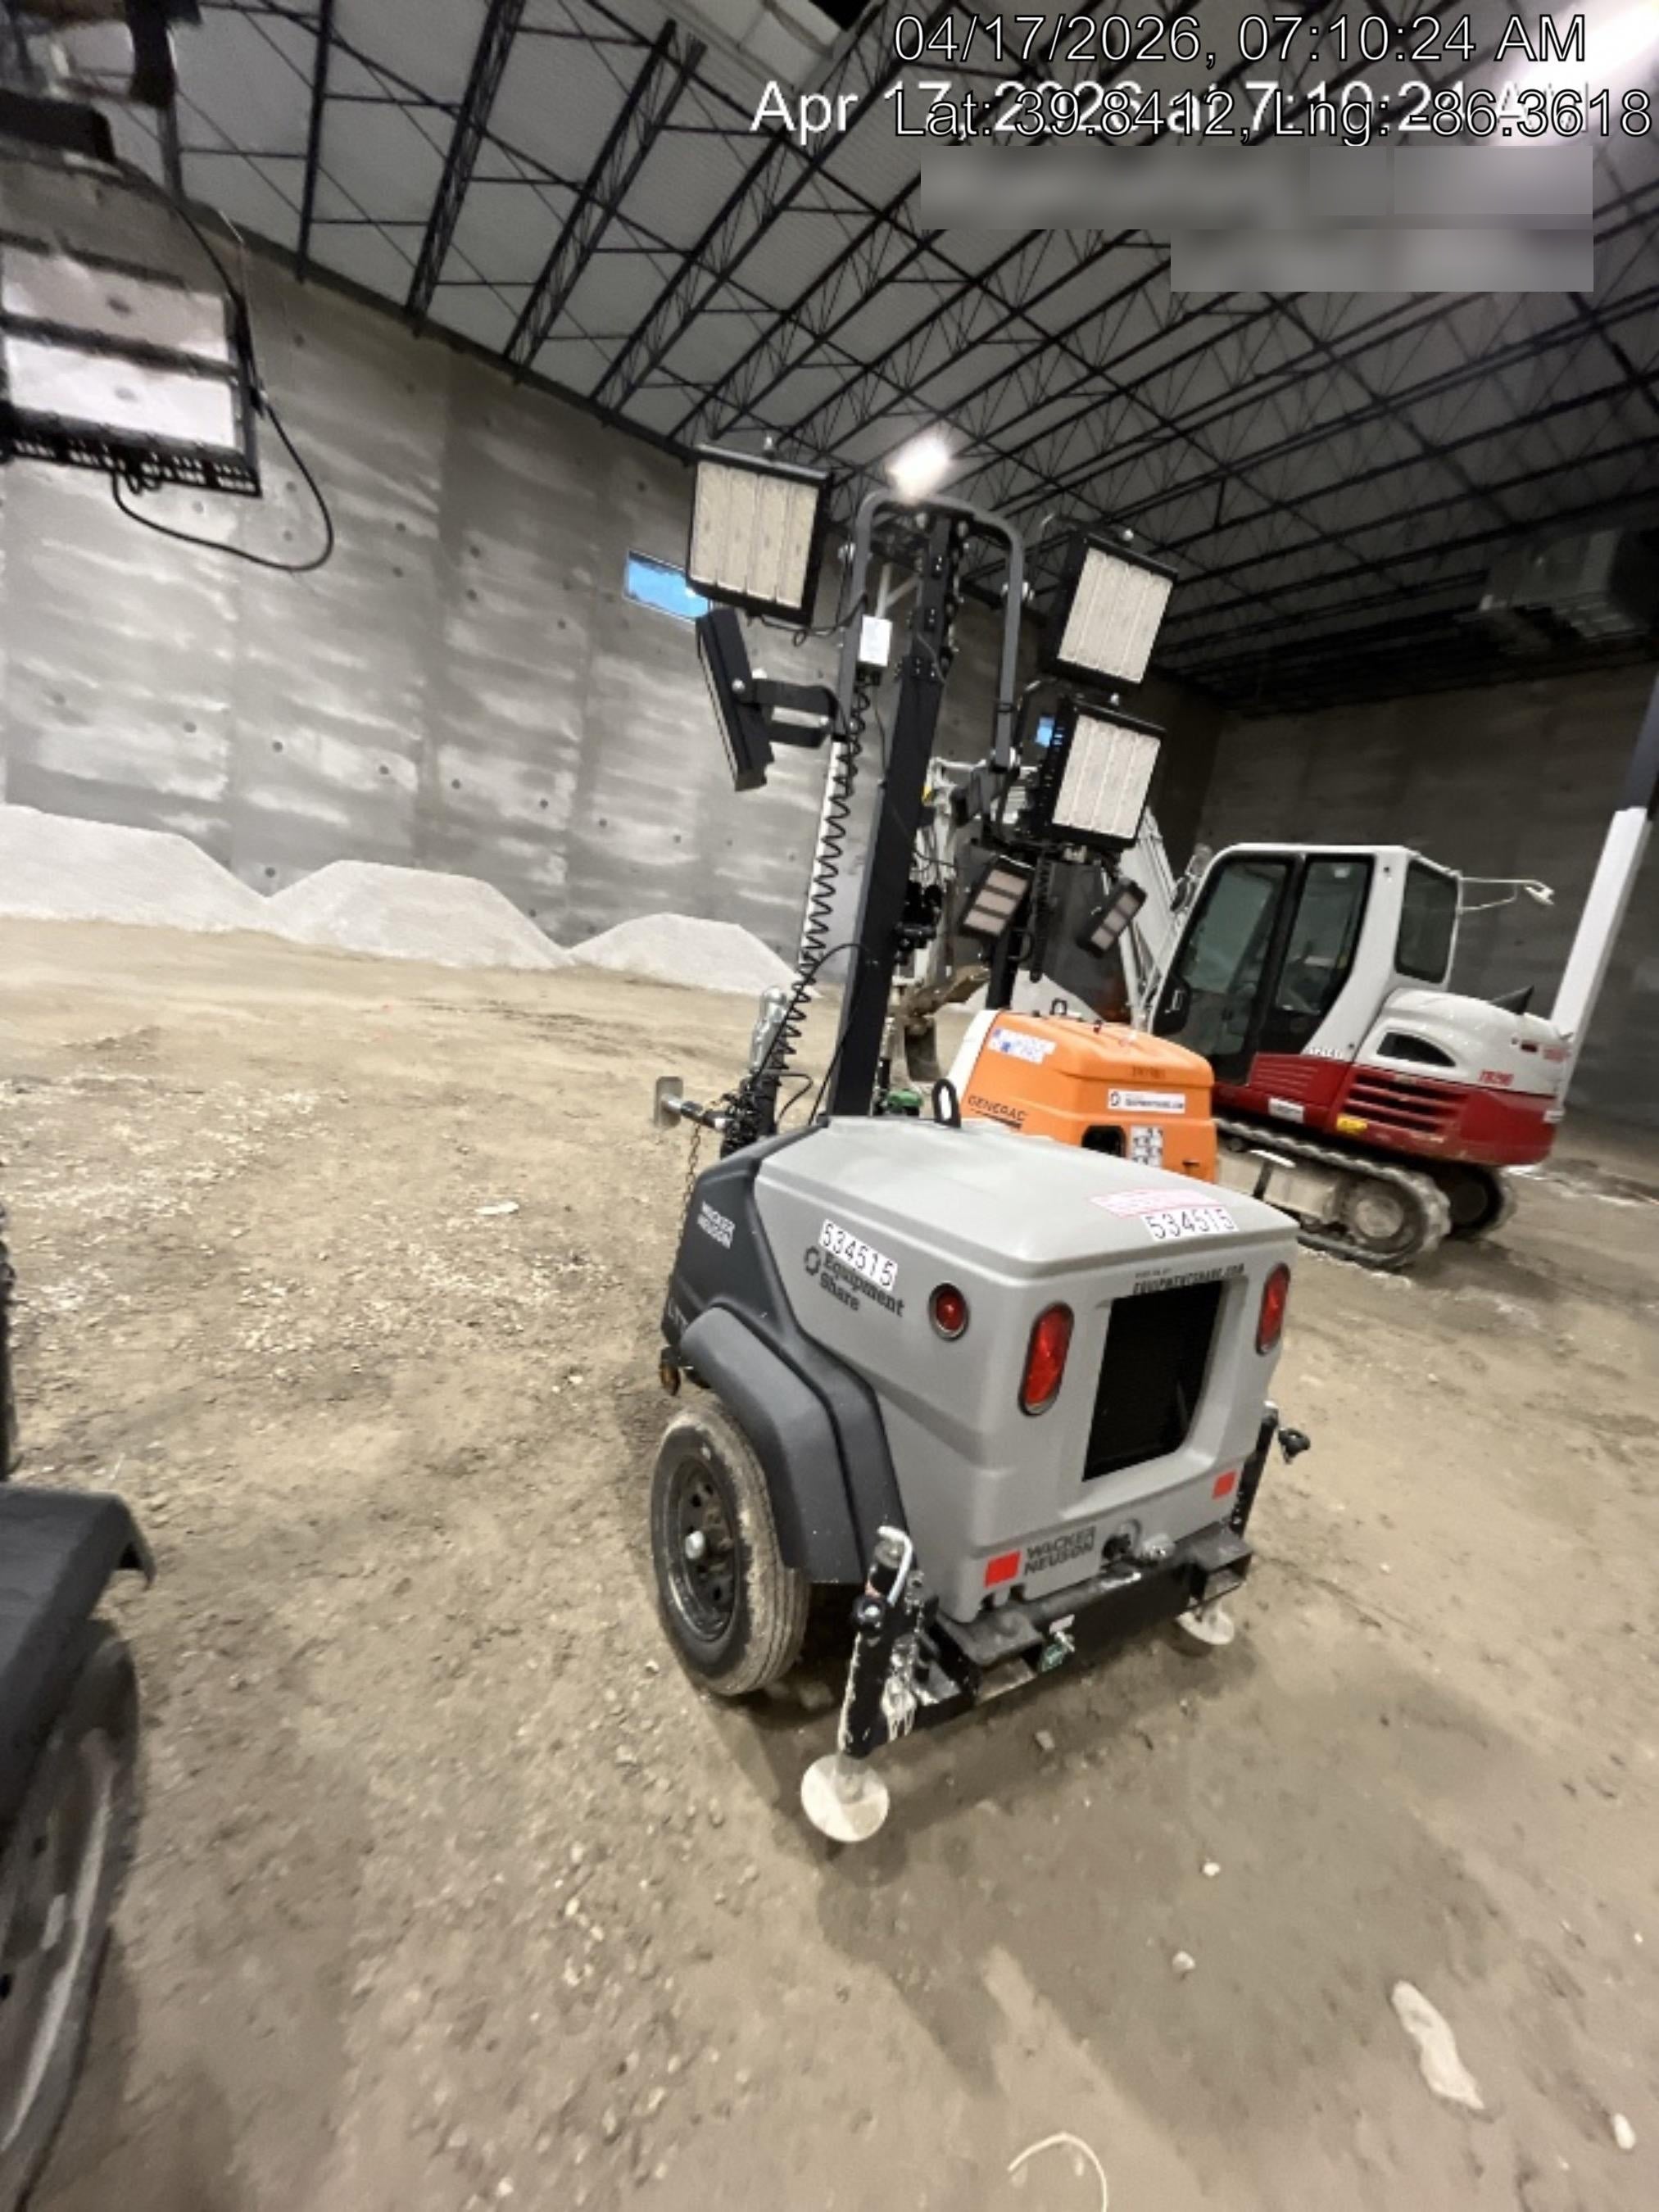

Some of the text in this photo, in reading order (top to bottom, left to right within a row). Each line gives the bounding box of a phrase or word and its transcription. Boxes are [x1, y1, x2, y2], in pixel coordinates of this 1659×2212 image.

[968, 1095, 1029, 1122] GENERAC
[1145, 1208, 1235, 1240] 534515
[823, 1222, 895, 1287] 534515
[820, 1271, 860, 1312] Share
[822, 1251, 905, 1317] Equipment
[1026, 1525, 1096, 1558] WACKER
[1024, 1543, 1095, 1575] NEUSON
